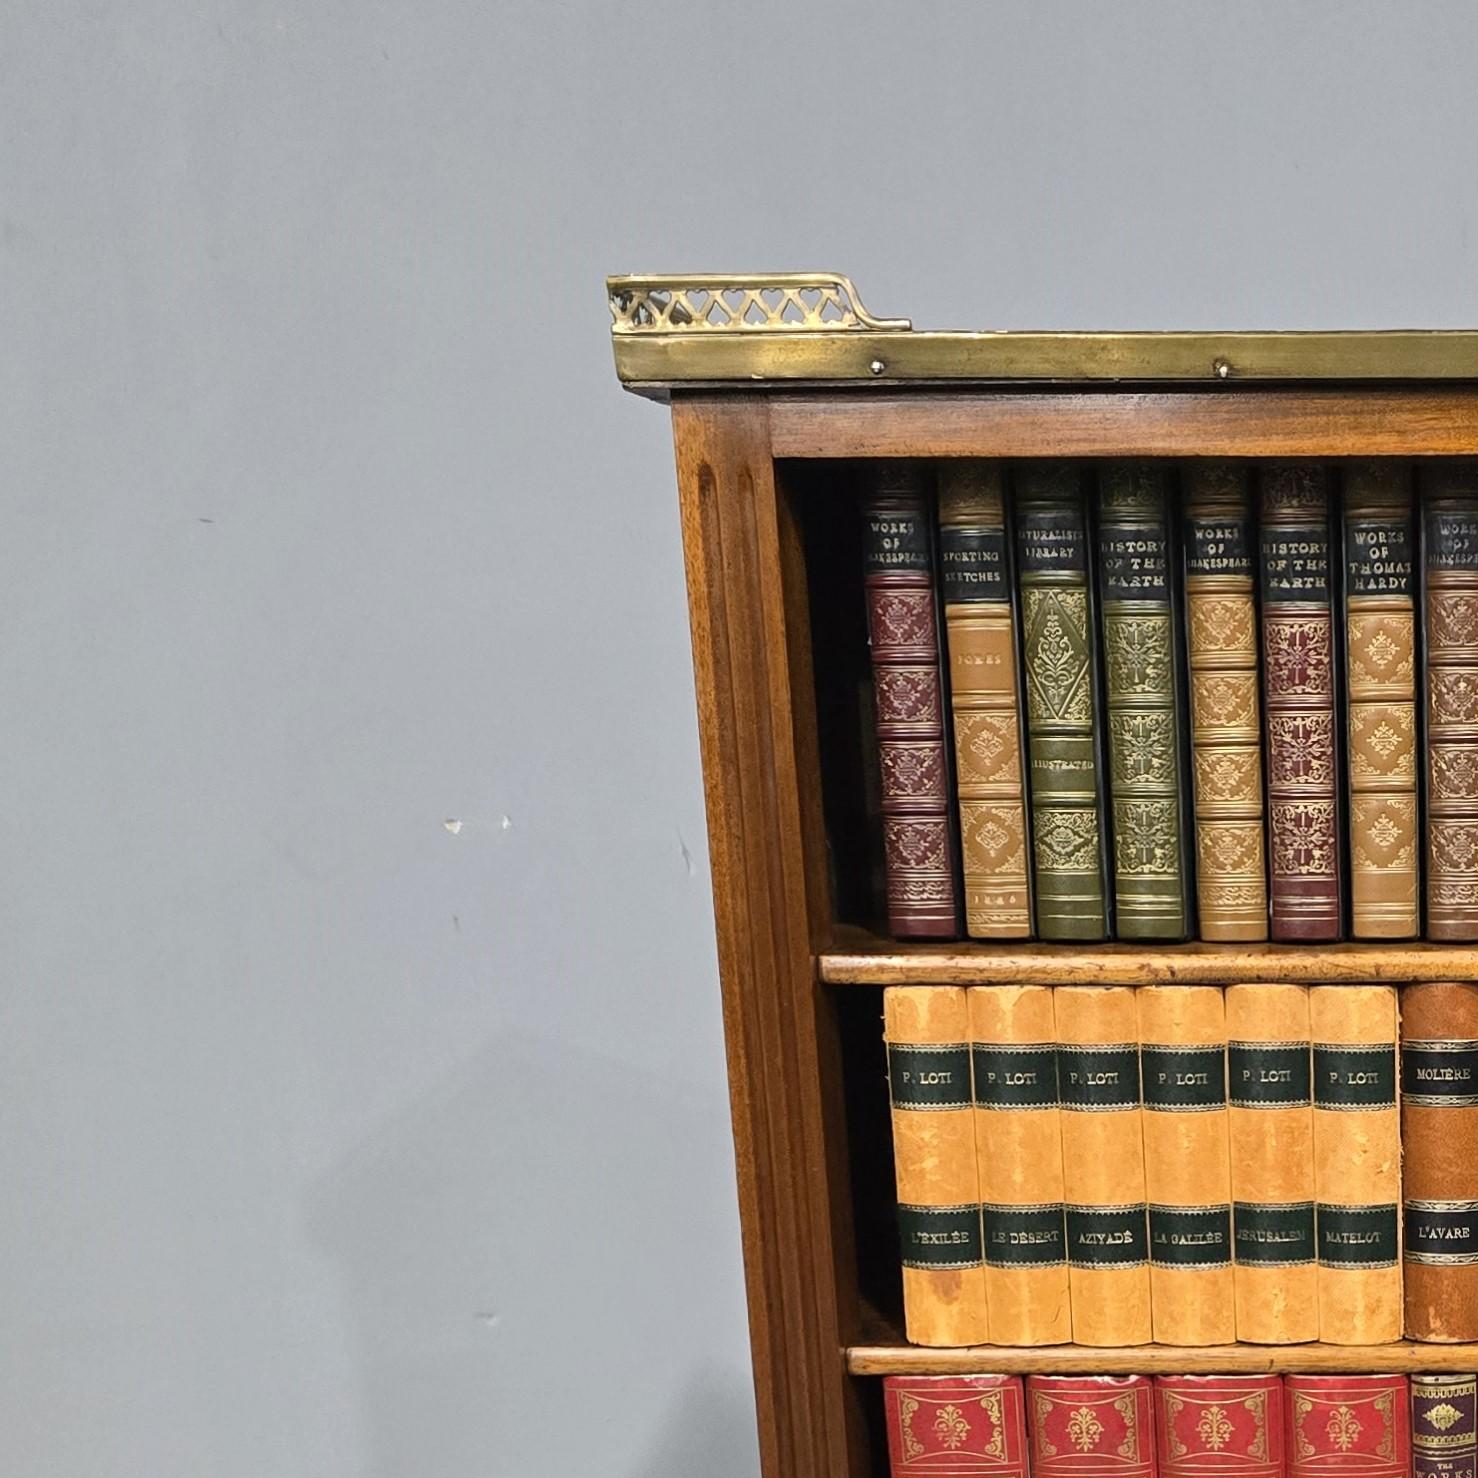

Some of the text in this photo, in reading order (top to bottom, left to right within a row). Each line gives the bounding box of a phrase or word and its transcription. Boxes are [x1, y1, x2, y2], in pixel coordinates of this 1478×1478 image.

[1354, 532, 1404, 545] WORKS
[943, 551, 999, 562] SPORTING
[1369, 547, 1389, 559] OF
[1267, 560, 1327, 571] OF THE
[1349, 562, 1412, 574] THOMAS
[1269, 578, 1326, 588] EARTH
[1355, 577, 1407, 590] HARDY
[919, 1072, 952, 1084] LOTI
[1005, 1073, 1037, 1085] LOTI
[1086, 1072, 1119, 1085] LOTI
[1176, 1073, 1208, 1085] LOTI
[1260, 1070, 1292, 1082] LOTI
[1347, 1072, 1379, 1084] LOTI
[992, 1232, 1006, 1244] LE
[1154, 1232, 1168, 1244] LA
[1326, 1232, 1382, 1244] MATELOT
[1419, 1226, 1470, 1239] L'AVARE
